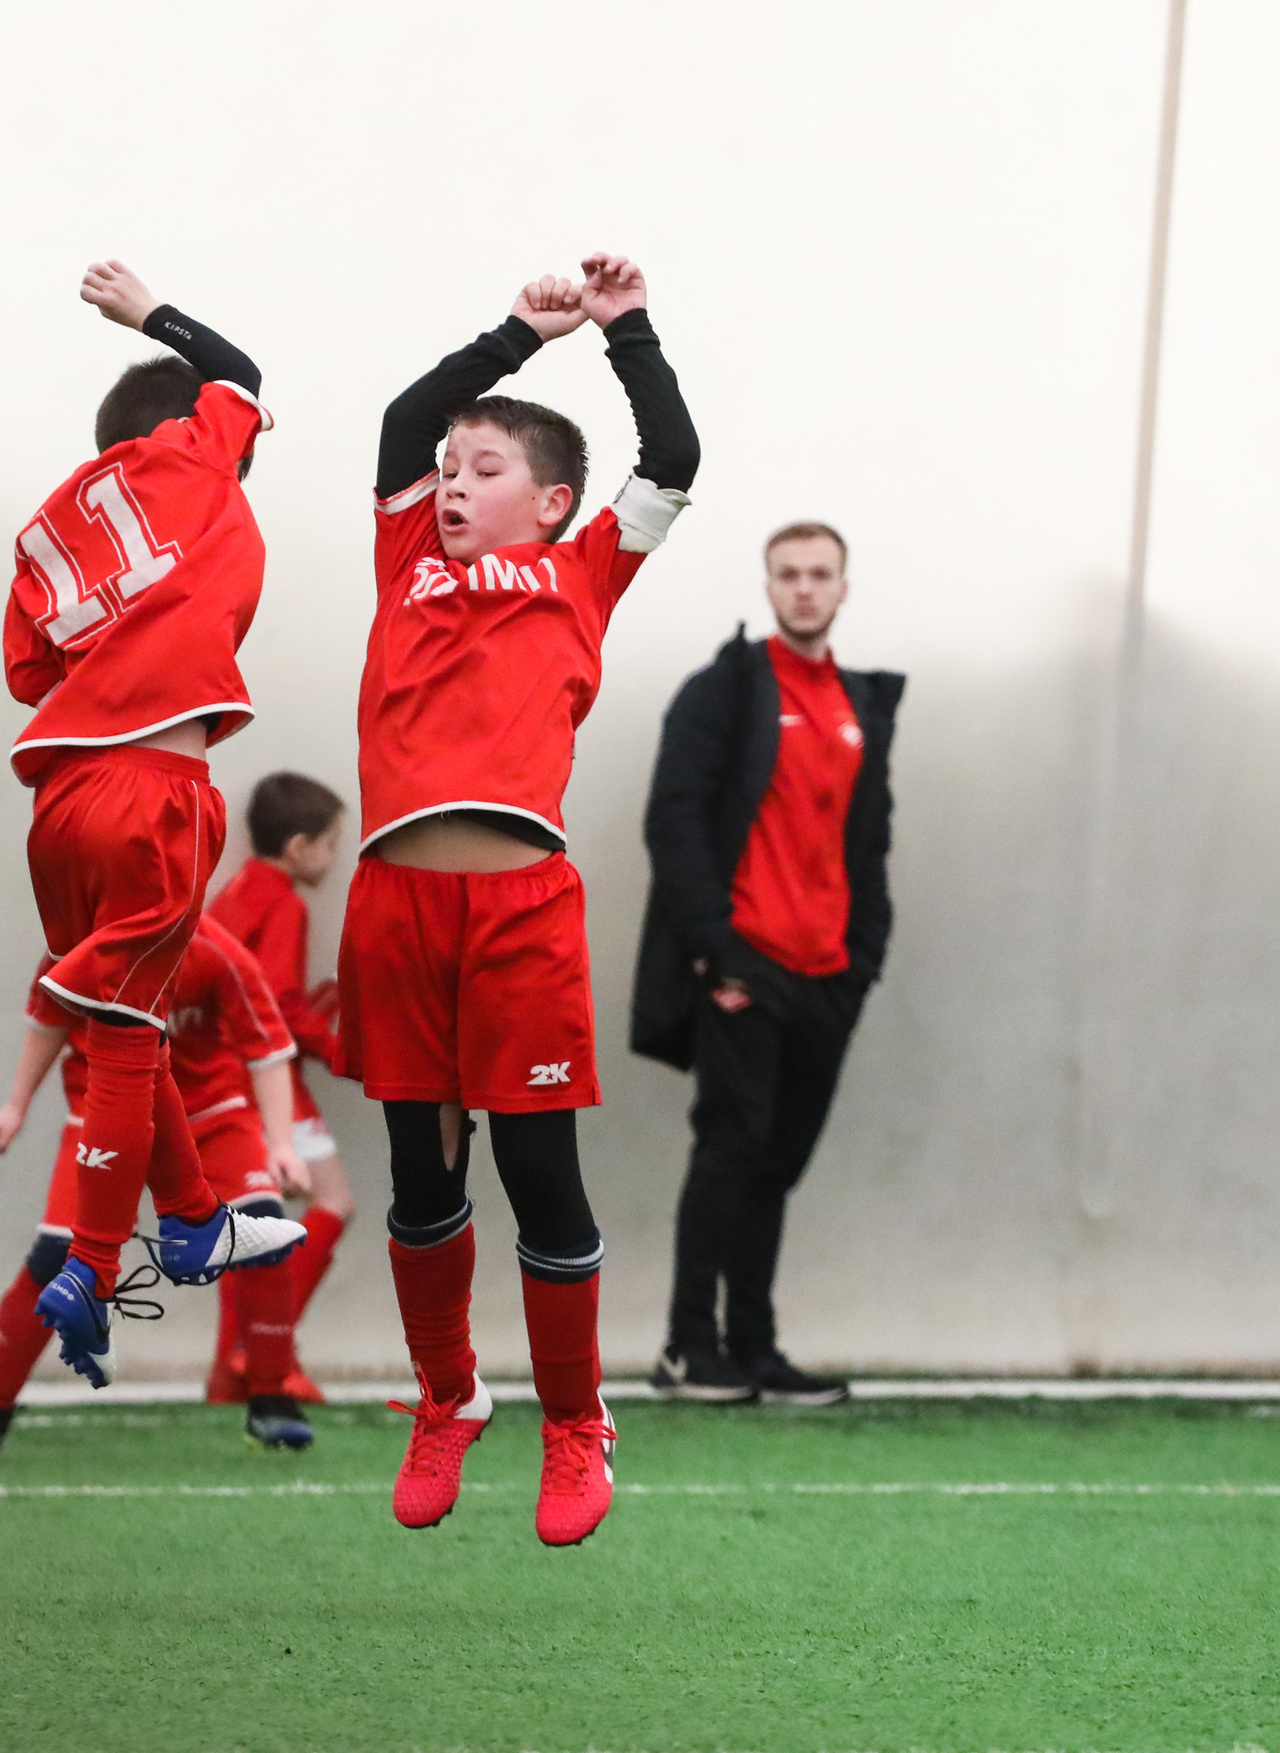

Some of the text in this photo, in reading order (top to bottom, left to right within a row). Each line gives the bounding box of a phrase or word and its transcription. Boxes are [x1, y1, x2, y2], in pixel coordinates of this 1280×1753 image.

[164, 321, 192, 340] KIPSTA
[16, 462, 183, 650] 11
[526, 1061, 571, 1085] 2K
